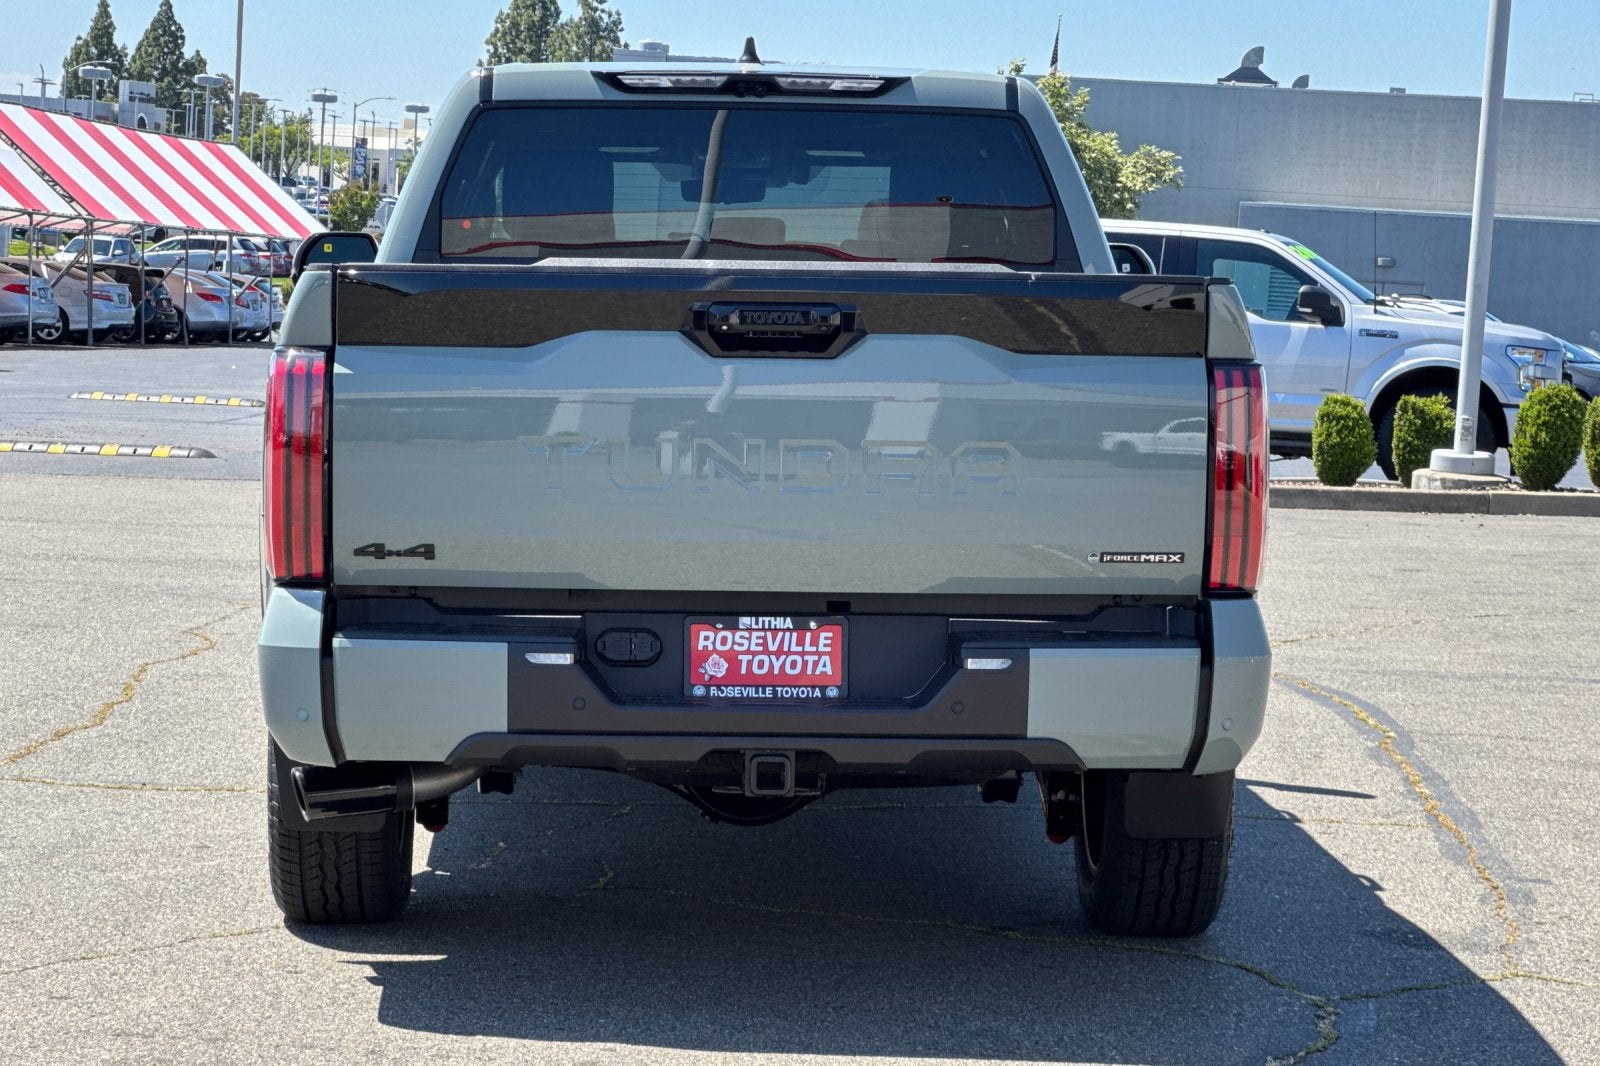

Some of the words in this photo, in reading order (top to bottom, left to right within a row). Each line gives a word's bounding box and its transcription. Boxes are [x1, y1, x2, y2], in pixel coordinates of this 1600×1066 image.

[743, 311, 805, 324] TOYOTA
[517, 435, 1023, 497] TUNDRA
[751, 617, 793, 629] LITHIA
[697, 631, 834, 652] ROSEVILLE
[737, 654, 833, 675] TOYOTA
